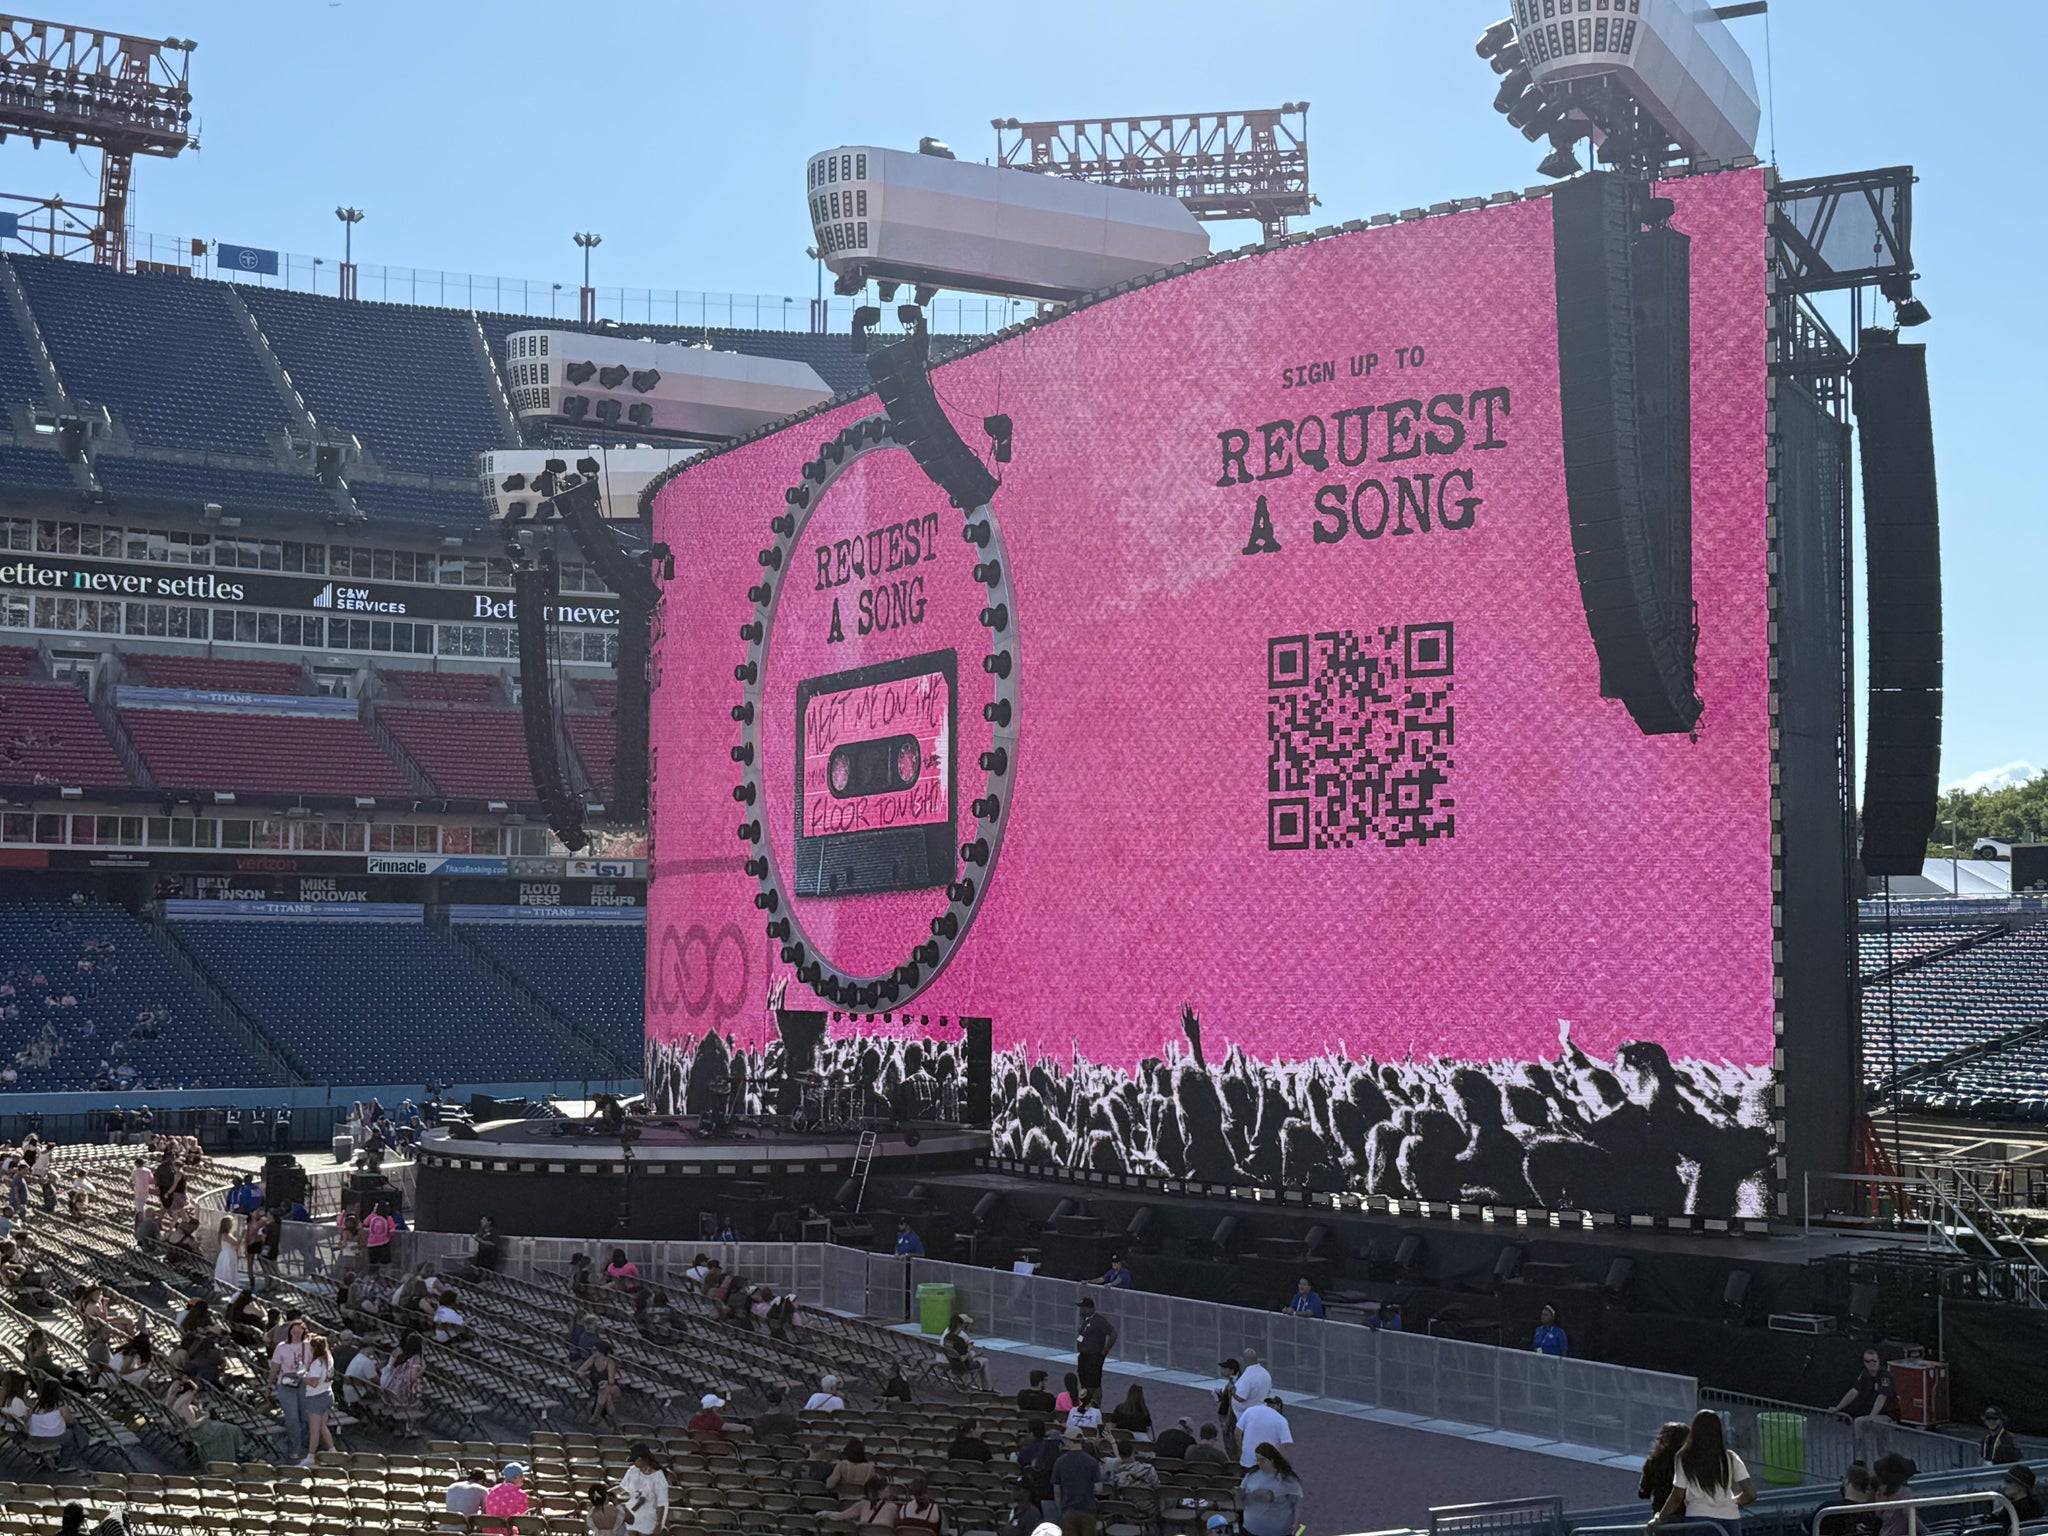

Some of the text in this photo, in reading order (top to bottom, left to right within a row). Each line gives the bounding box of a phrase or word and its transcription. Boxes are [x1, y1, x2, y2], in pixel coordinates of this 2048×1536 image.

[1282, 345, 1425, 389] SIGN UP TO
[1216, 387, 1511, 487] REQUEST
[1242, 468, 1484, 555] A SONG
[815, 512, 939, 591] REQUEST
[0, 561, 244, 601] etter never settles
[336, 587, 369, 601] C&W
[336, 598, 407, 614] SERVICES
[473, 594, 553, 621] Betr
[827, 576, 928, 644] A SONG
[210, 693, 252, 704] TITANS
[811, 796, 871, 836] FLOOR
[236, 857, 297, 872] verizon
[369, 859, 426, 873] Pinnacle
[590, 865, 626, 877] tsu
[300, 879, 336, 890] MIKE
[519, 883, 561, 894] FLOYD
[590, 884, 617, 895] JEFF
[300, 890, 368, 902] HOLOVAK
[267, 903, 311, 913] TITANS
[533, 908, 575, 917] TITANS
